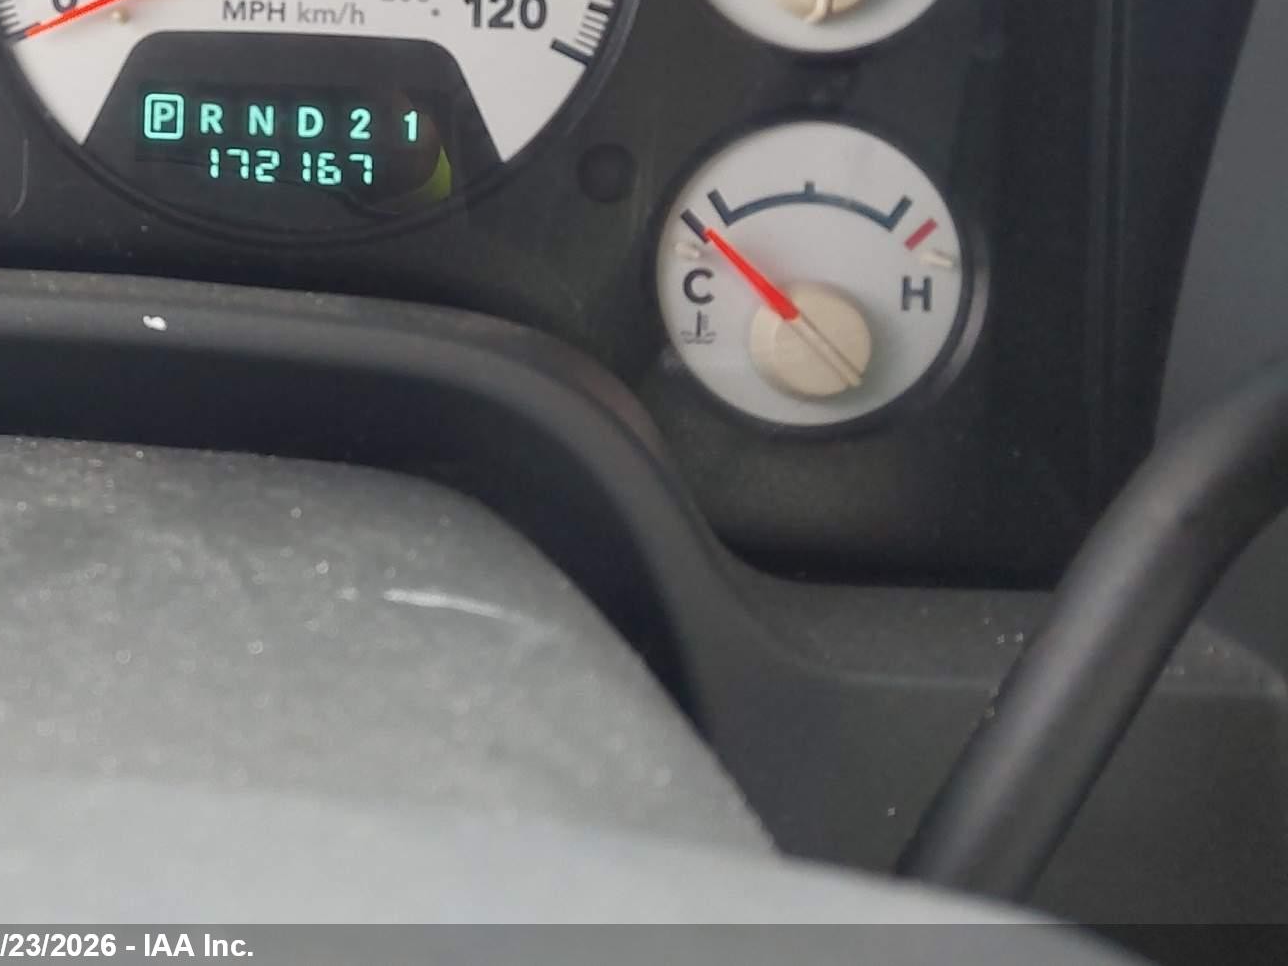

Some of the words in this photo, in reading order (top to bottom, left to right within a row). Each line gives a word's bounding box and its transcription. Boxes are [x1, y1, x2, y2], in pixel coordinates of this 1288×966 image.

[223, 0, 286, 23] MPH
[297, 1, 365, 25] km/h
[153, 103, 177, 131] P
[200, 103, 223, 134] R
[248, 105, 274, 136] N
[297, 106, 324, 138] D
[350, 108, 371, 139] 2
[404, 110, 418, 141] 1
[210, 148, 373, 185] 172167
[682, 268, 714, 305] C
[901, 276, 932, 312] H
